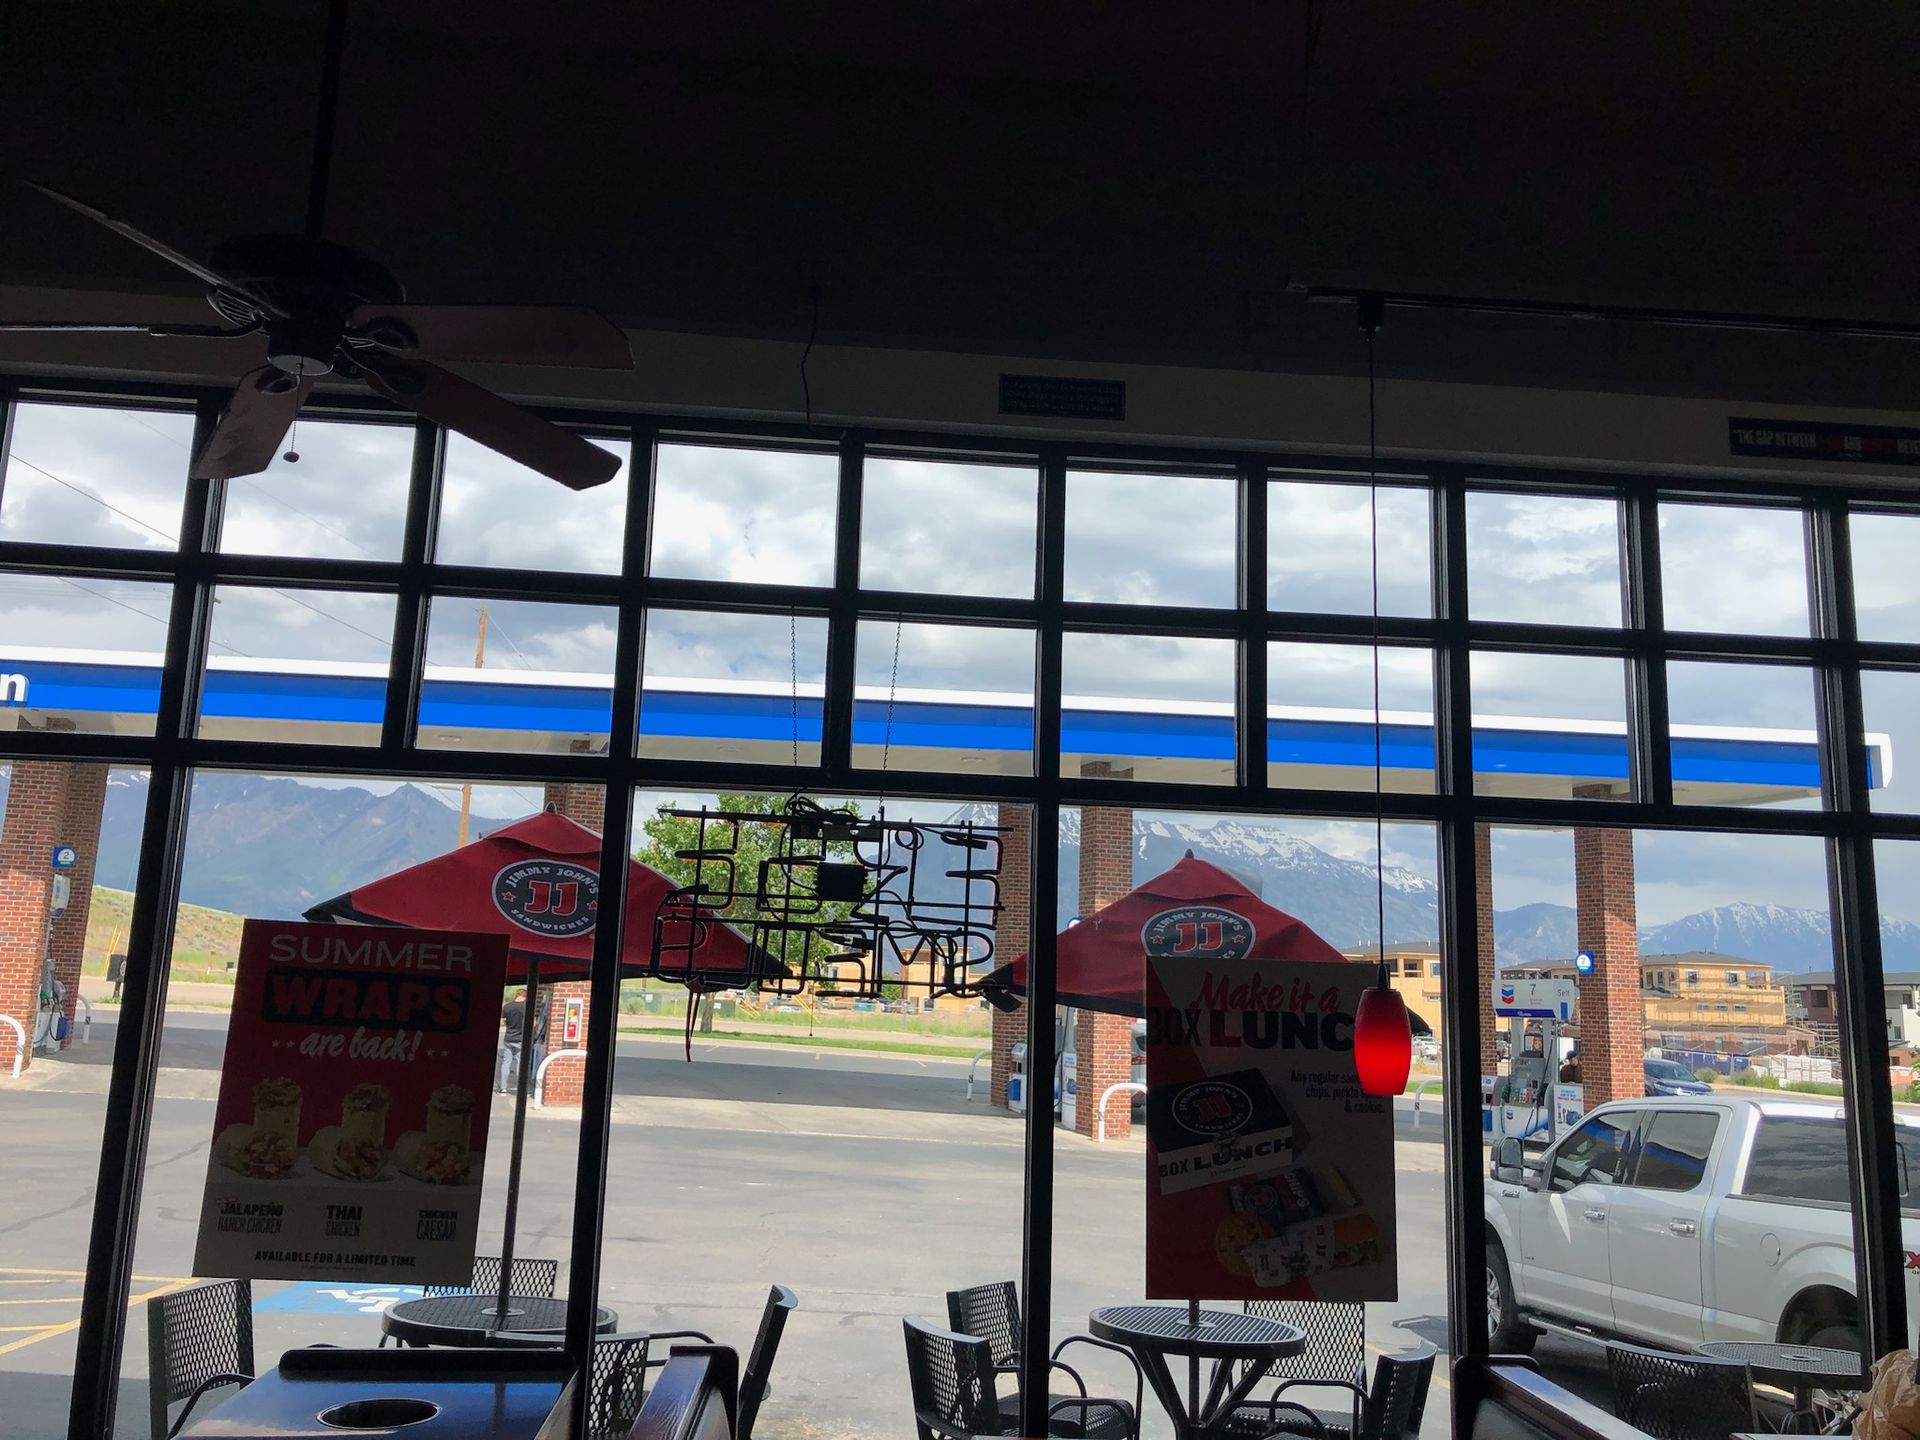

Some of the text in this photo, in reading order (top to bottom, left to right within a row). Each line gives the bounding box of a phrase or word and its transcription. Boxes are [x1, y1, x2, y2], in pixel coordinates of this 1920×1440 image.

[1775, 431, 1817, 449] BETWEEN
[63, 851, 70, 860] 2
[505, 866, 599, 894] JIMMY JOHN'S
[524, 880, 579, 916] JJ
[511, 909, 590, 931] SANDWICHES
[1153, 911, 1244, 932] JIMMY JOHN'S
[1173, 921, 1223, 953] JJ
[269, 934, 473, 972] SUMMER
[1190, 970, 1340, 1013] Make it a
[1529, 983, 1537, 996] 7
[1557, 989, 1570, 998] Self
[273, 975, 464, 1026] WRAPS
[1210, 1008, 1354, 1052] LUNC
[299, 1026, 422, 1062] are back!
[1291, 1070, 1307, 1086] Any
[1308, 1070, 1340, 1086] regular
[1332, 1086, 1359, 1100] pickle
[1160, 1158, 1190, 1178] BOX
[1193, 1135, 1293, 1171] LUNCH
[326, 1204, 363, 1221] THAI
[418, 1209, 458, 1220] CHICKEN
[247, 1217, 282, 1234] CHICKEN
[325, 1220, 361, 1237] CHICKEN
[416, 1219, 457, 1241] CAESAR
[255, 1249, 416, 1267] AVAILABLE FOR A LIMITED TIME
